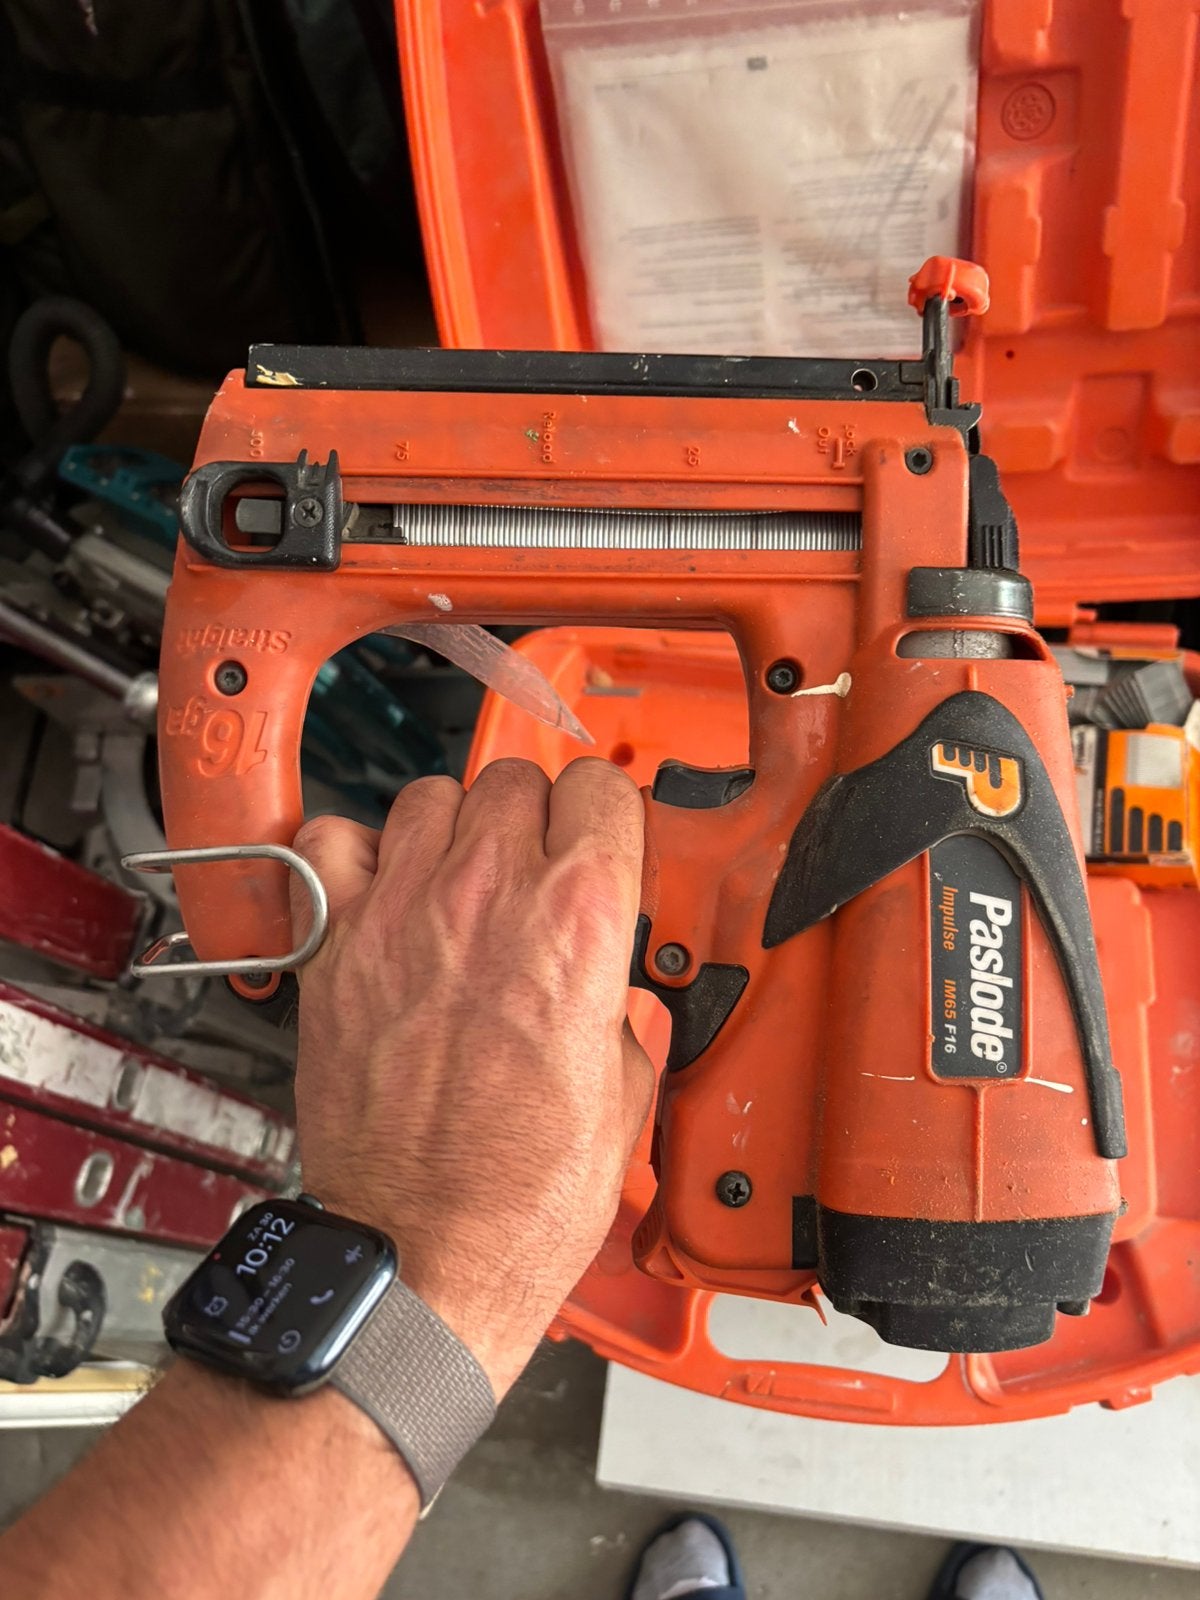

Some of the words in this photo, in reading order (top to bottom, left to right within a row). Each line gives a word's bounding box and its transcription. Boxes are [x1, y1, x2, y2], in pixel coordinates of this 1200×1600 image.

[177, 623, 292, 657] Straight
[938, 885, 959, 951] Impulse
[943, 979, 957, 1019] IM65
[943, 1023, 957, 1054] F16
[235, 1217, 296, 1276] 10:12
